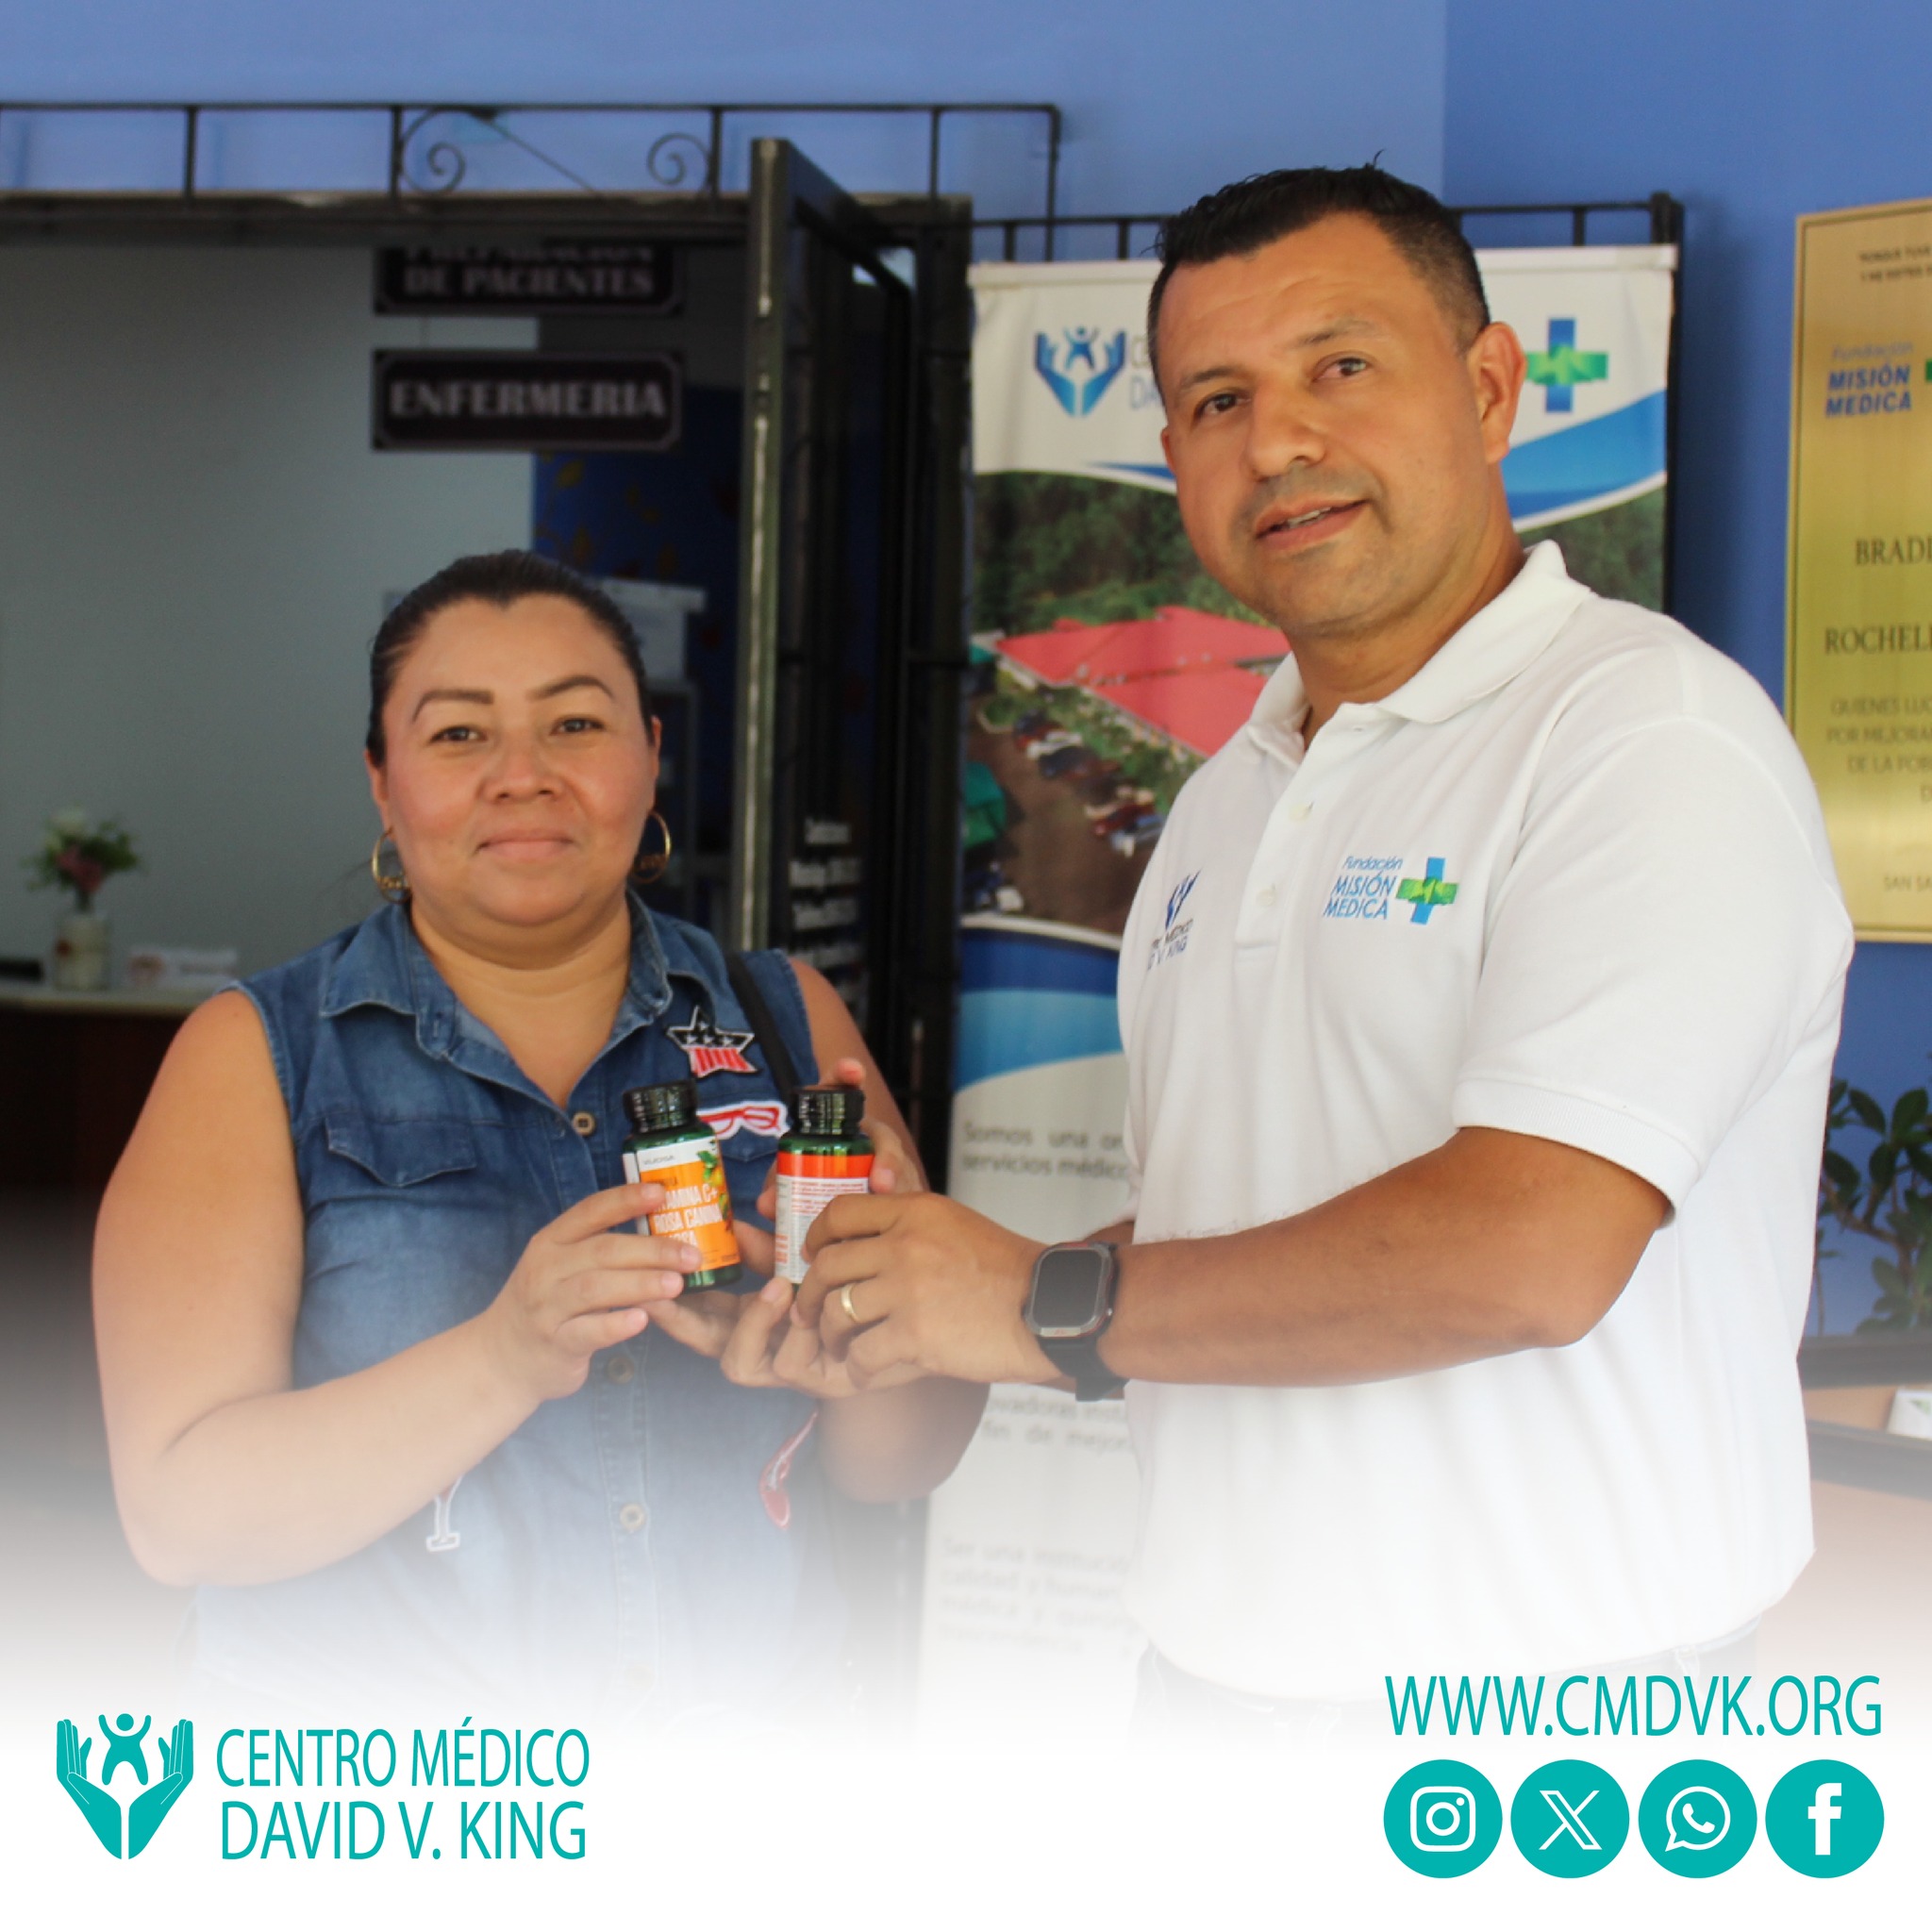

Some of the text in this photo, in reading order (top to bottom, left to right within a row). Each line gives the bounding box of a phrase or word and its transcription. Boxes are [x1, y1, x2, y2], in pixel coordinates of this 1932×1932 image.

[404, 264, 656, 297] DE PACIENTES
[1829, 360, 1910, 391] MISIÓN
[389, 379, 666, 417] ENFERMERIA
[1824, 390, 1912, 418] MEDICA
[1341, 855, 1404, 870] Fundación
[1329, 870, 1397, 897] MISIÓN
[1322, 897, 1389, 920] MEDICA
[963, 1120, 1033, 1144] Somos
[1047, 1131, 1089, 1148] una
[961, 1155, 1052, 1175] servicios
